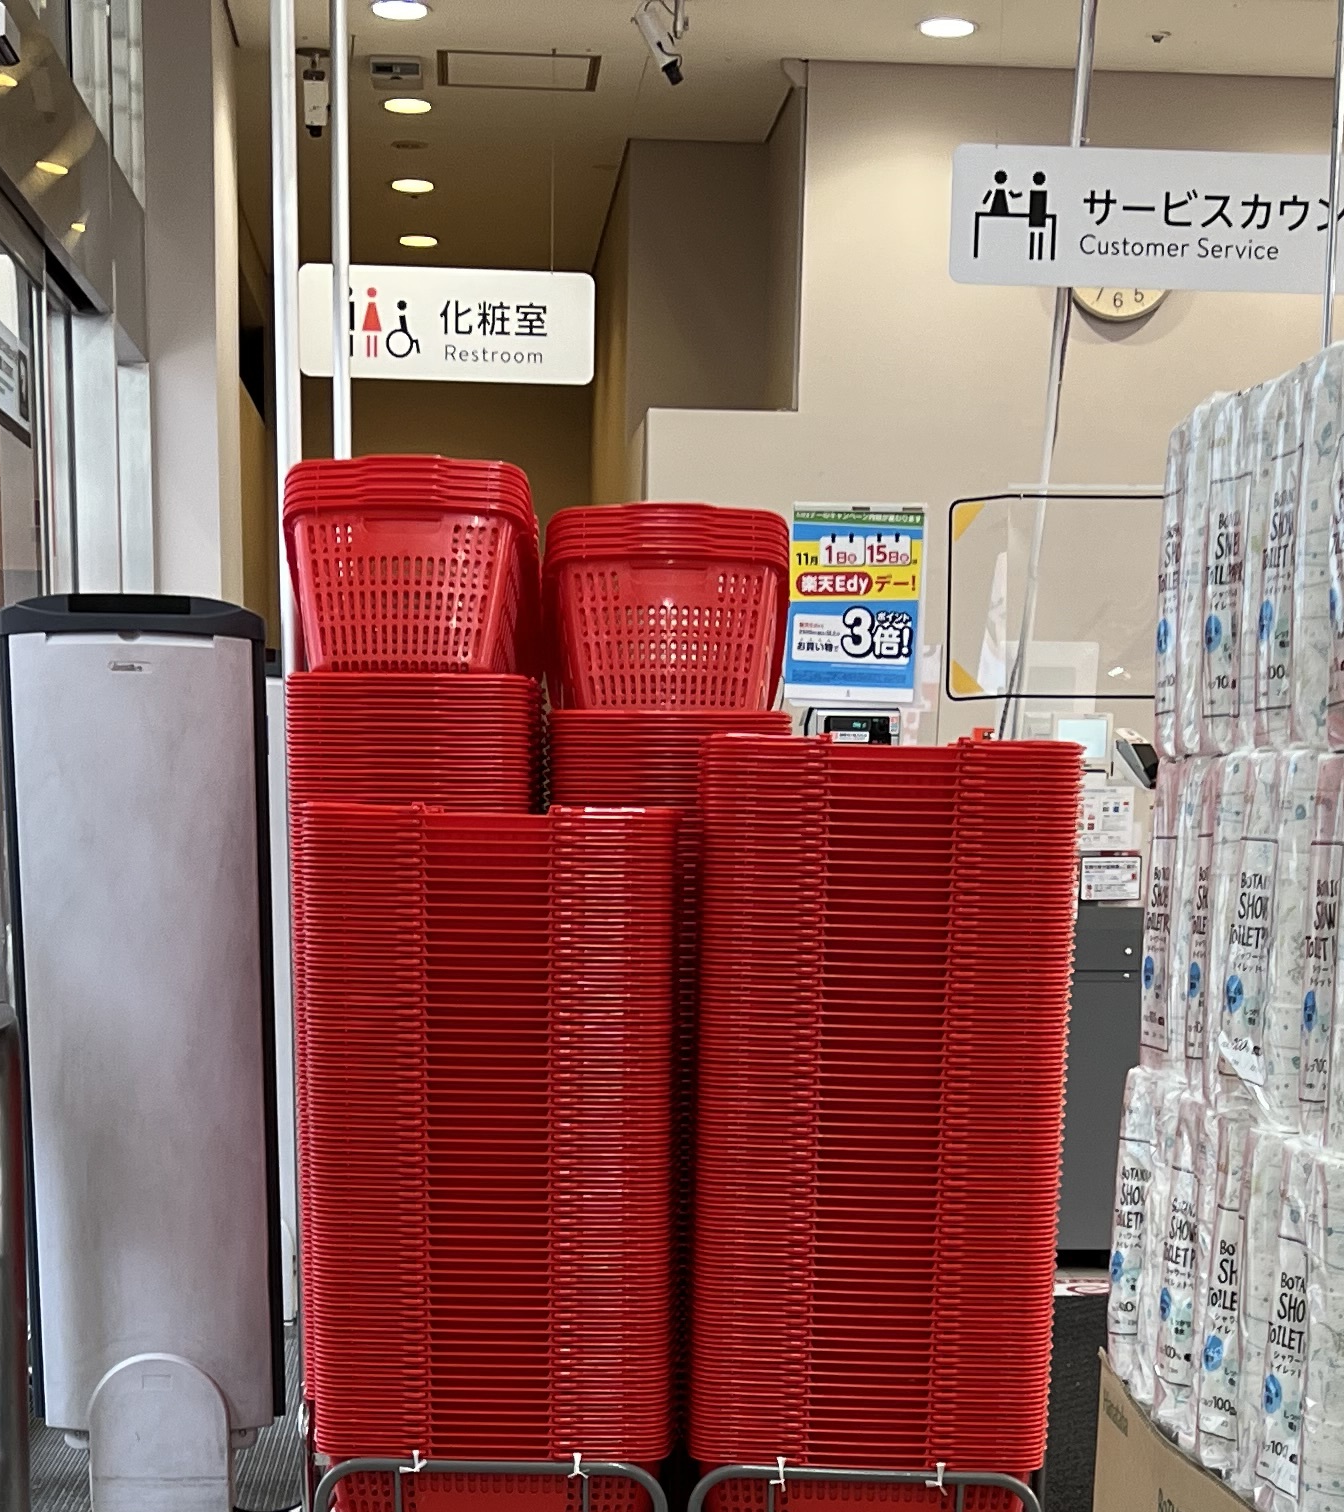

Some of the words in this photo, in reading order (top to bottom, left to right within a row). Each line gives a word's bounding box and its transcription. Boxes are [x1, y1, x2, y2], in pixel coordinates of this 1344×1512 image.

[1079, 233, 1190, 259] Customer
[1196, 237, 1281, 261] Service
[1112, 291, 1124, 309] 6
[439, 299, 550, 339] 化粧室
[443, 343, 545, 366] Restroom
[796, 552, 819, 566] 11月
